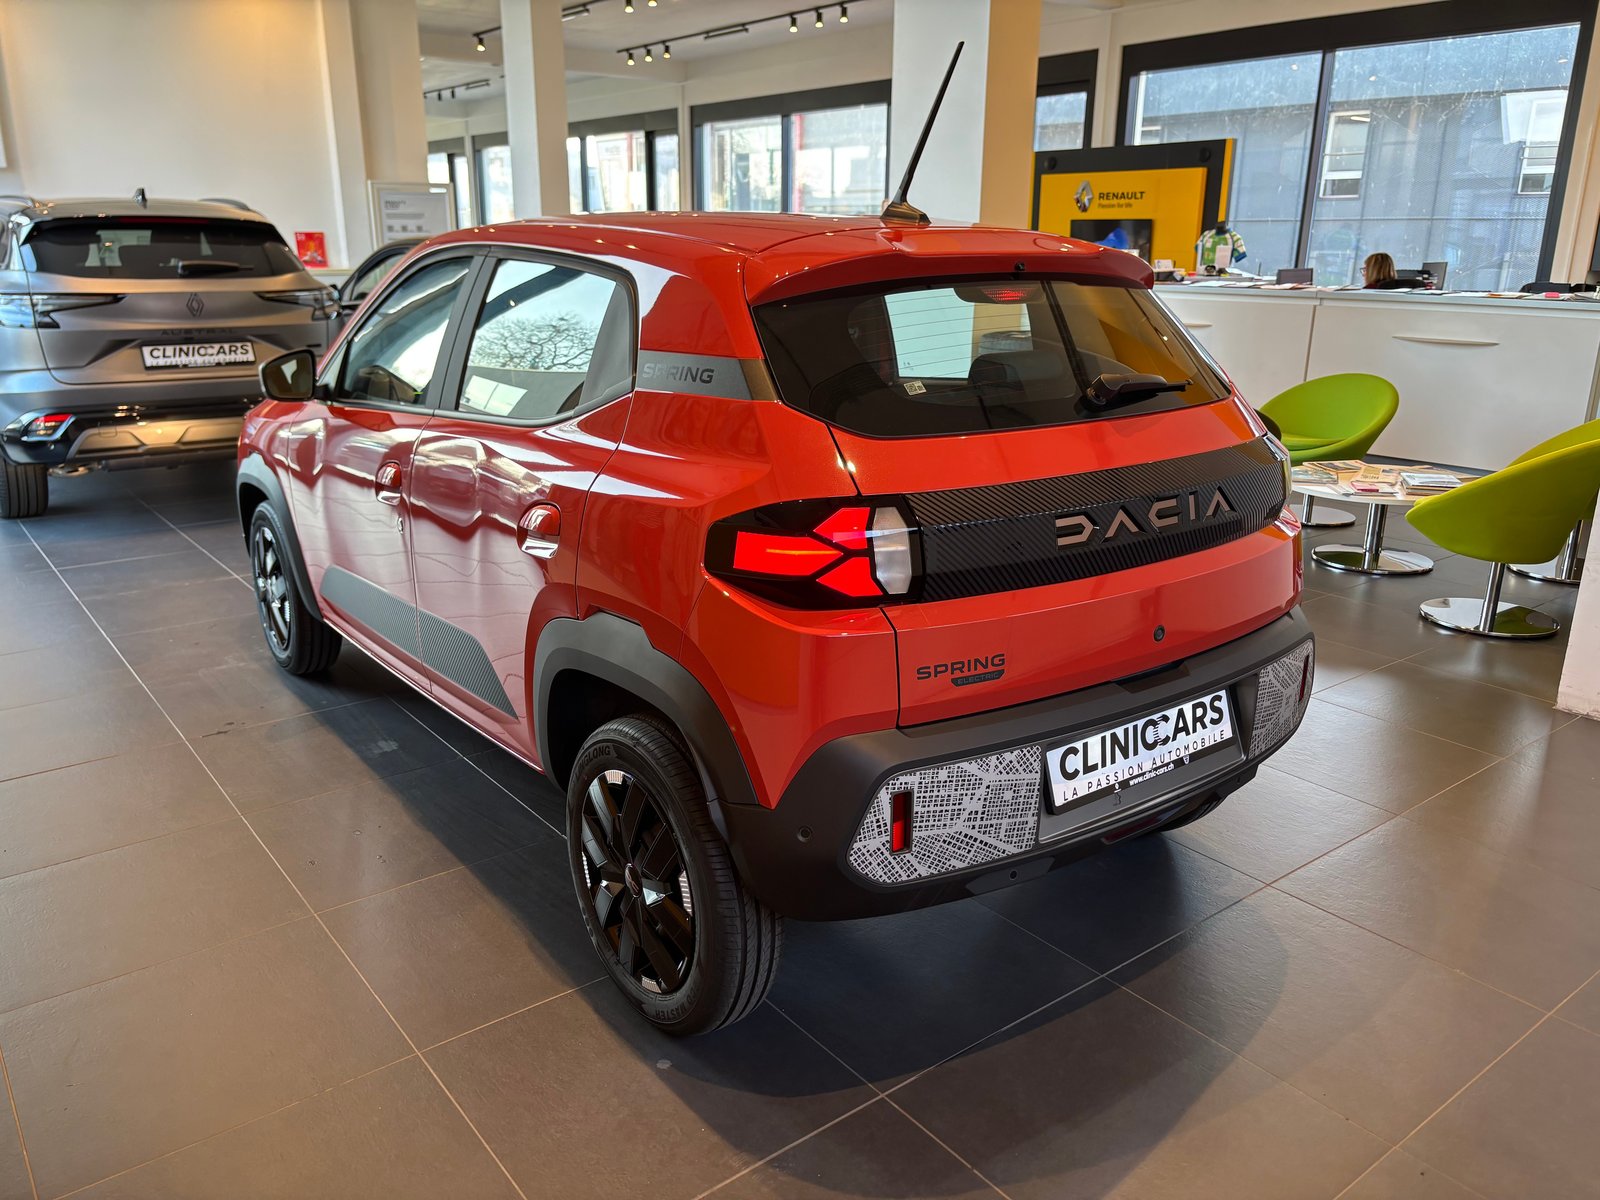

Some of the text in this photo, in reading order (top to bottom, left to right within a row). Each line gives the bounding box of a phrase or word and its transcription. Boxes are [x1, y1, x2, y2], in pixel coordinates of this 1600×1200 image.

[1098, 191, 1145, 201] RENAULT
[642, 362, 715, 384] SPRING
[1055, 486, 1237, 546] DACIA
[916, 653, 1005, 680] SPRING
[957, 671, 999, 685] ELECTRIC
[1063, 729, 1225, 801] LA PASSION AUTOMOBILE
[1128, 763, 1175, 786] www.clinic-cars.ch
